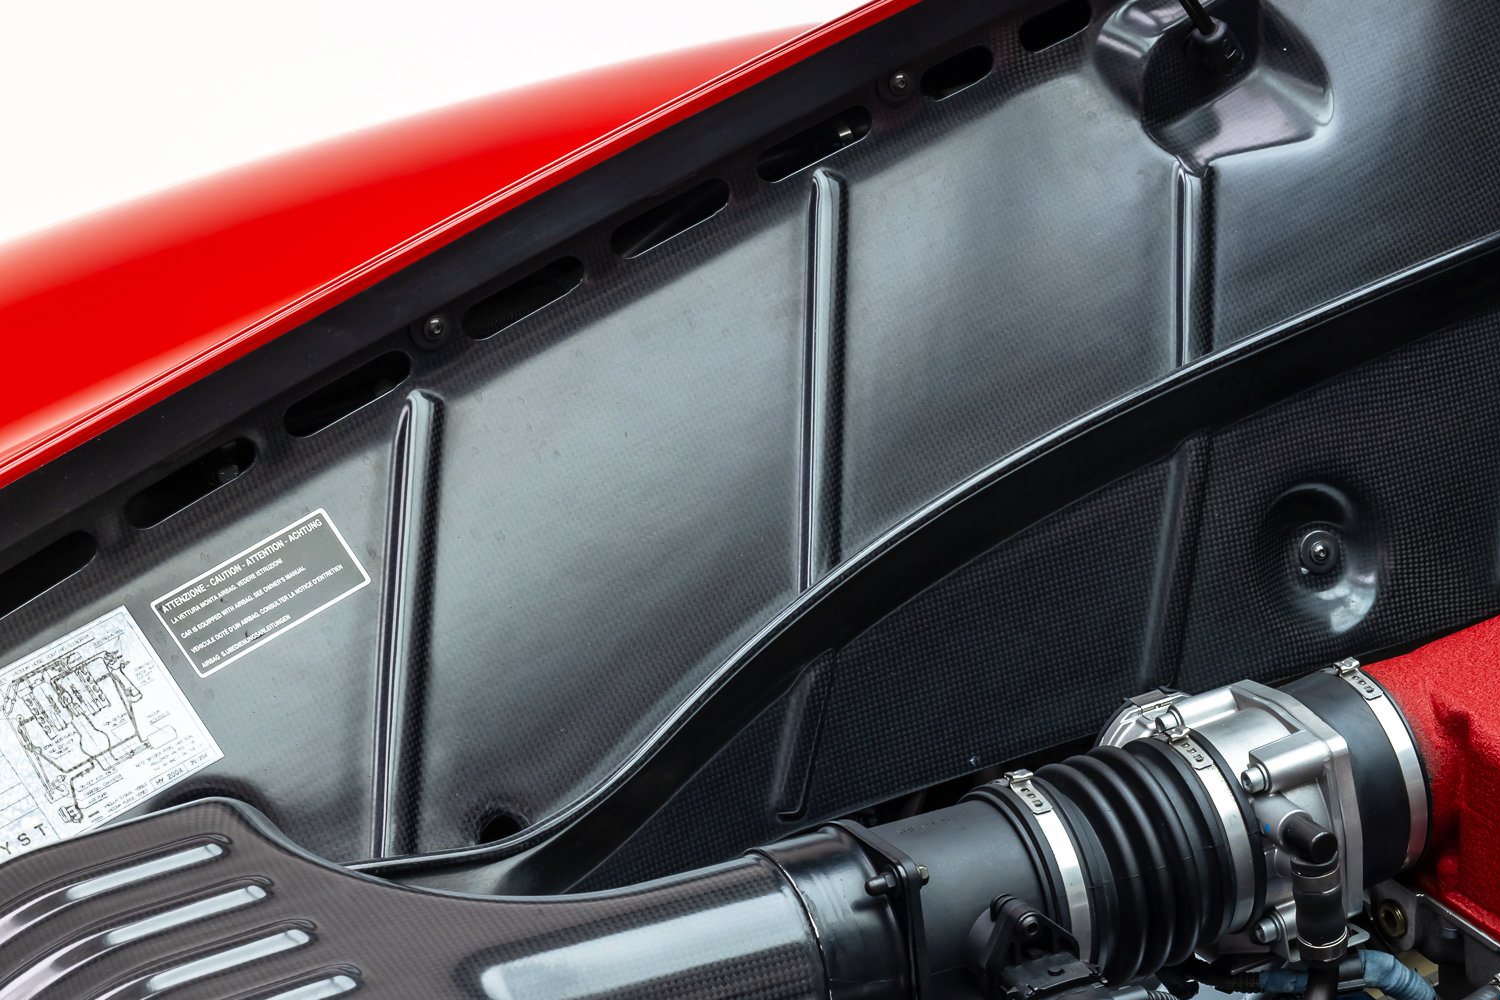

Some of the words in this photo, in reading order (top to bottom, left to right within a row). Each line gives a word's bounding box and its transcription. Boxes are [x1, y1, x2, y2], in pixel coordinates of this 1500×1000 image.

[162, 583, 207, 613] ATTENZIONE
[209, 563, 242, 586] CAUTION
[245, 539, 285, 567] ATTENTION
[288, 518, 323, 543] ACHTUNG
[287, 591, 296, 599] LA
[294, 581, 314, 595] NOTICE
[170, 617, 179, 625] LA
[177, 604, 201, 620] VETTURA
[199, 595, 219, 608] MONTA
[236, 573, 257, 587] VEDERE
[180, 629, 193, 639] CAR
[196, 612, 223, 630] EQUIPPED
[221, 605, 235, 616] WITH
[253, 589, 264, 598] SEE
[284, 565, 306, 580] MANUAL
